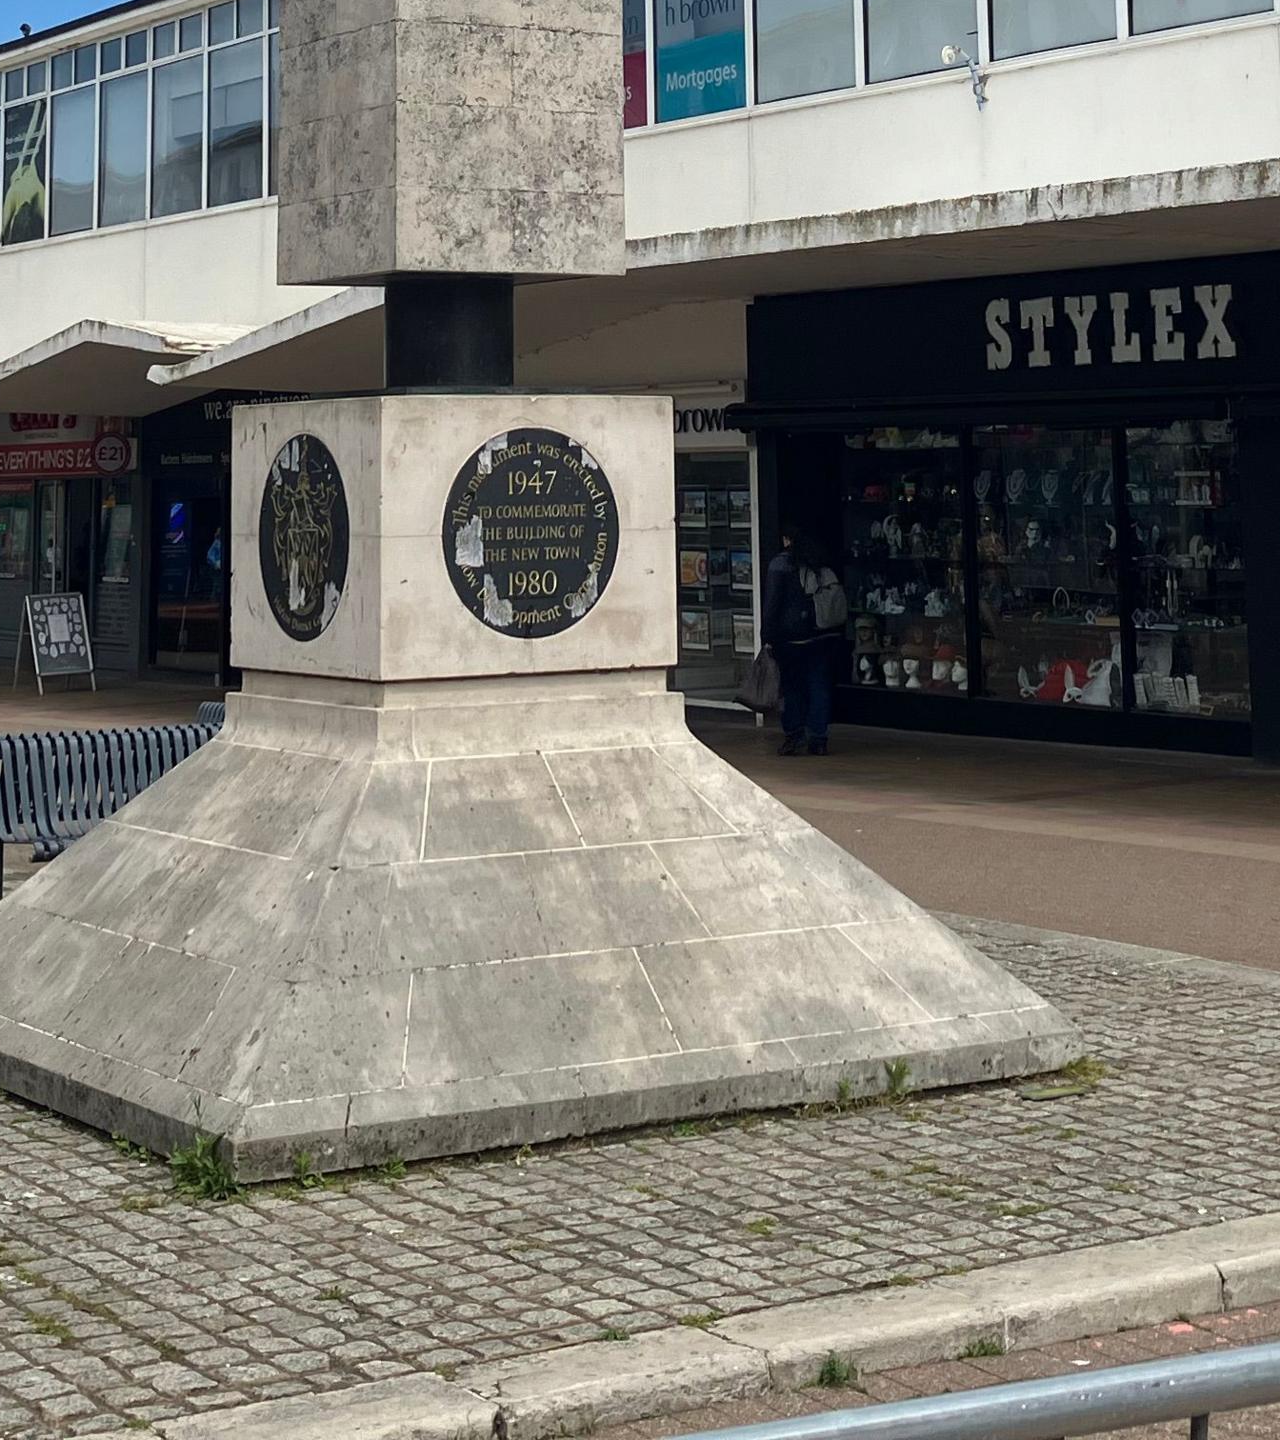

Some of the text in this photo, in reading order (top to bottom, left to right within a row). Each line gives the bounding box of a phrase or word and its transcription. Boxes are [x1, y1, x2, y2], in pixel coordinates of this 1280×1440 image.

[665, 0, 675, 26] h
[666, 64, 738, 92] Mortgages
[985, 284, 1237, 371] STYLEX
[97, 445, 126, 461] £21
[453, 441, 609, 526] This moument was erected by
[508, 470, 557, 496] 1947
[477, 503, 587, 519] TO COMMEMORATE
[482, 524, 585, 541] THE BUILDING OF
[485, 546, 580, 561] THE NEW TOWN
[508, 570, 558, 596] 1980
